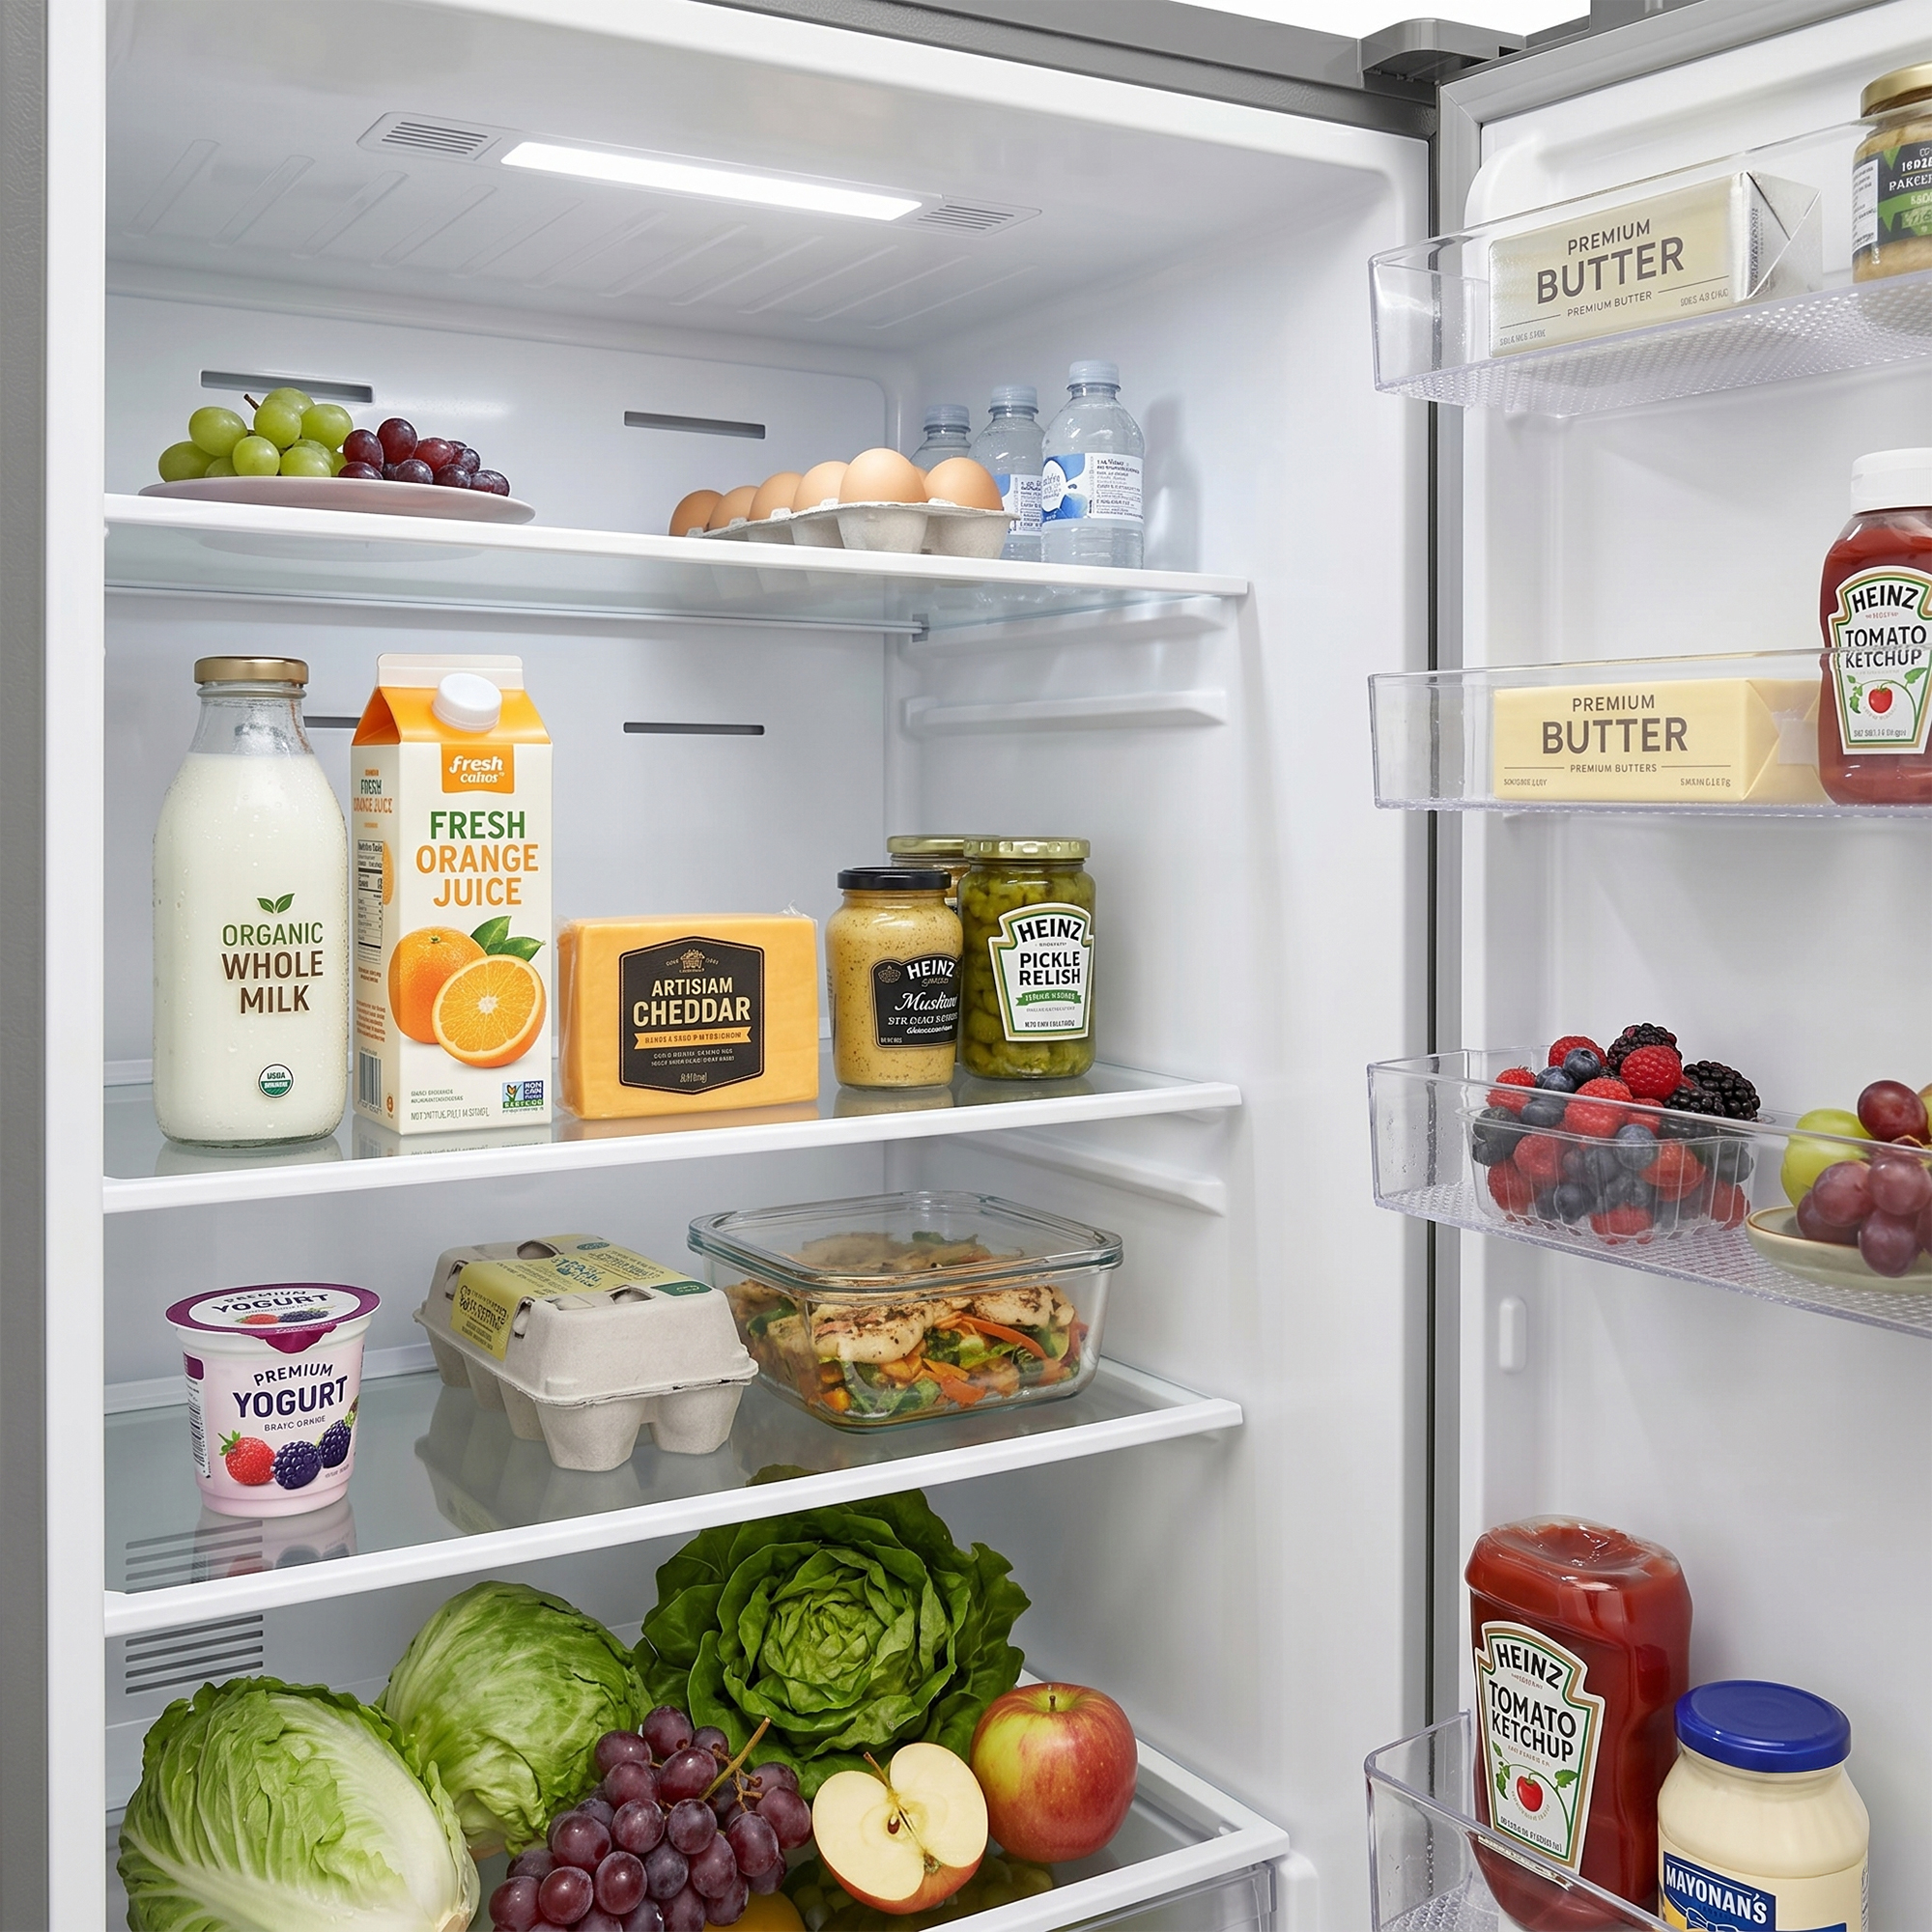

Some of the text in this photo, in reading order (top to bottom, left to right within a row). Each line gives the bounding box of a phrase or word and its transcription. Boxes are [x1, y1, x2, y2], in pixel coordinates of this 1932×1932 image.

[1568, 218, 1650, 256] PREMIUM
[1537, 236, 1684, 305] BUTTER
[1567, 290, 1652, 317] PREMIUM BUTTER
[1852, 584, 1919, 613] HEINZ
[1845, 625, 1927, 647] TOMATO
[1845, 649, 1922, 668] KETCHUP
[1572, 695, 1655, 712] PREMIUM
[1542, 717, 1689, 754] BUTTER
[449, 755, 503, 774] fresh
[1570, 763, 1657, 773] PREMIUM BUTTERS
[430, 810, 526, 839] FRESH
[415, 843, 539, 874] ORANGE
[433, 877, 523, 907] JUICE
[222, 922, 324, 947] ORGANIC
[1016, 918, 1083, 943] HEINZ
[221, 950, 324, 980] WHOLE
[906, 959, 955, 980] HEINZ
[1019, 951, 1081, 969] PICKLE
[651, 977, 733, 997] ARTISIAM
[1019, 968, 1081, 986] RELISH
[241, 984, 310, 1014] MILK
[633, 996, 752, 1027] CHEDDAR
[212, 1293, 329, 1314] YOGURT
[223, 1291, 307, 1303] PREMIUM
[253, 1363, 333, 1386] PREMIUM
[232, 1375, 348, 1418] YOGURT
[1495, 1643, 1564, 1690] HEINZ
[1488, 1679, 1577, 1739] TOMATO
[1492, 1709, 1574, 1762] KETCHUP
[1665, 1864, 1768, 1924] MAYONAN'S
